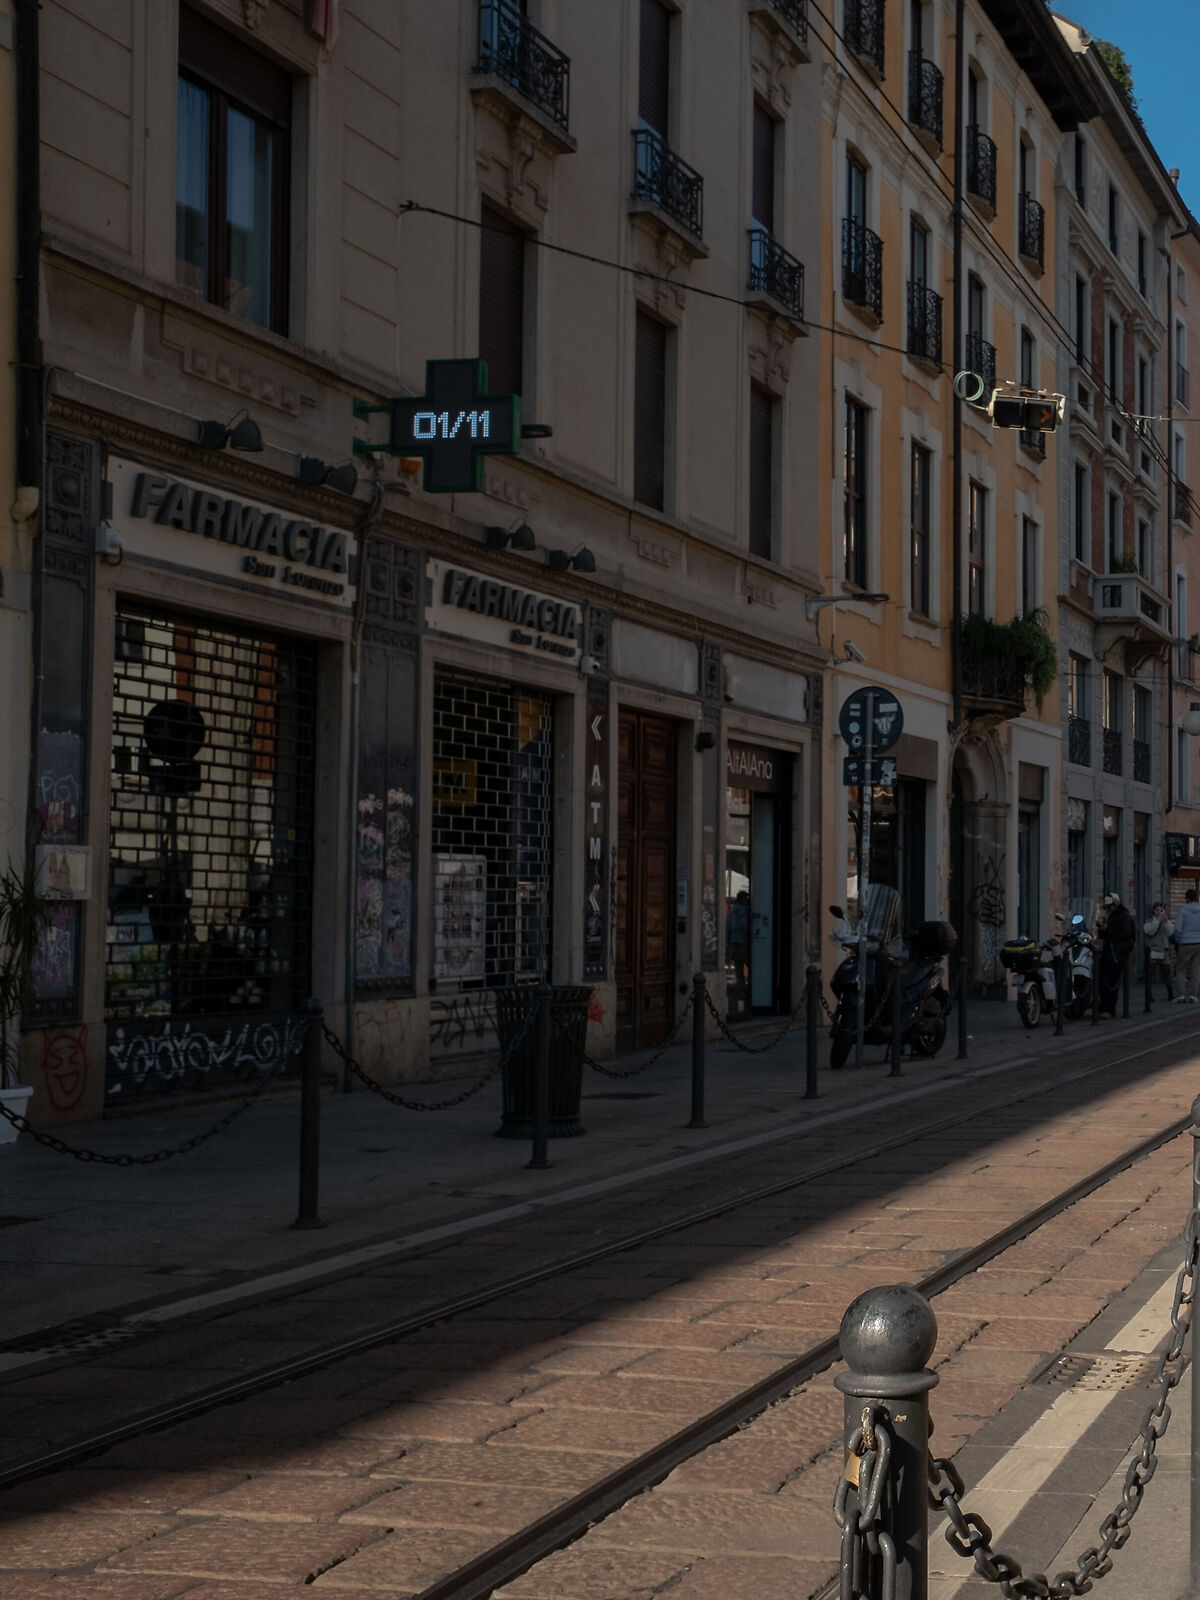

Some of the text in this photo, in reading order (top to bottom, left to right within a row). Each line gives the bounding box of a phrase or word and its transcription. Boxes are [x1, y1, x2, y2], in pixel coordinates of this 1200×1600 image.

[413, 410, 490, 439] 01/11
[131, 472, 347, 573] FARMACIA
[244, 555, 345, 596] San Lorenzo
[442, 569, 577, 640] FARMACIA
[510, 629, 576, 658] San Lorenzo
